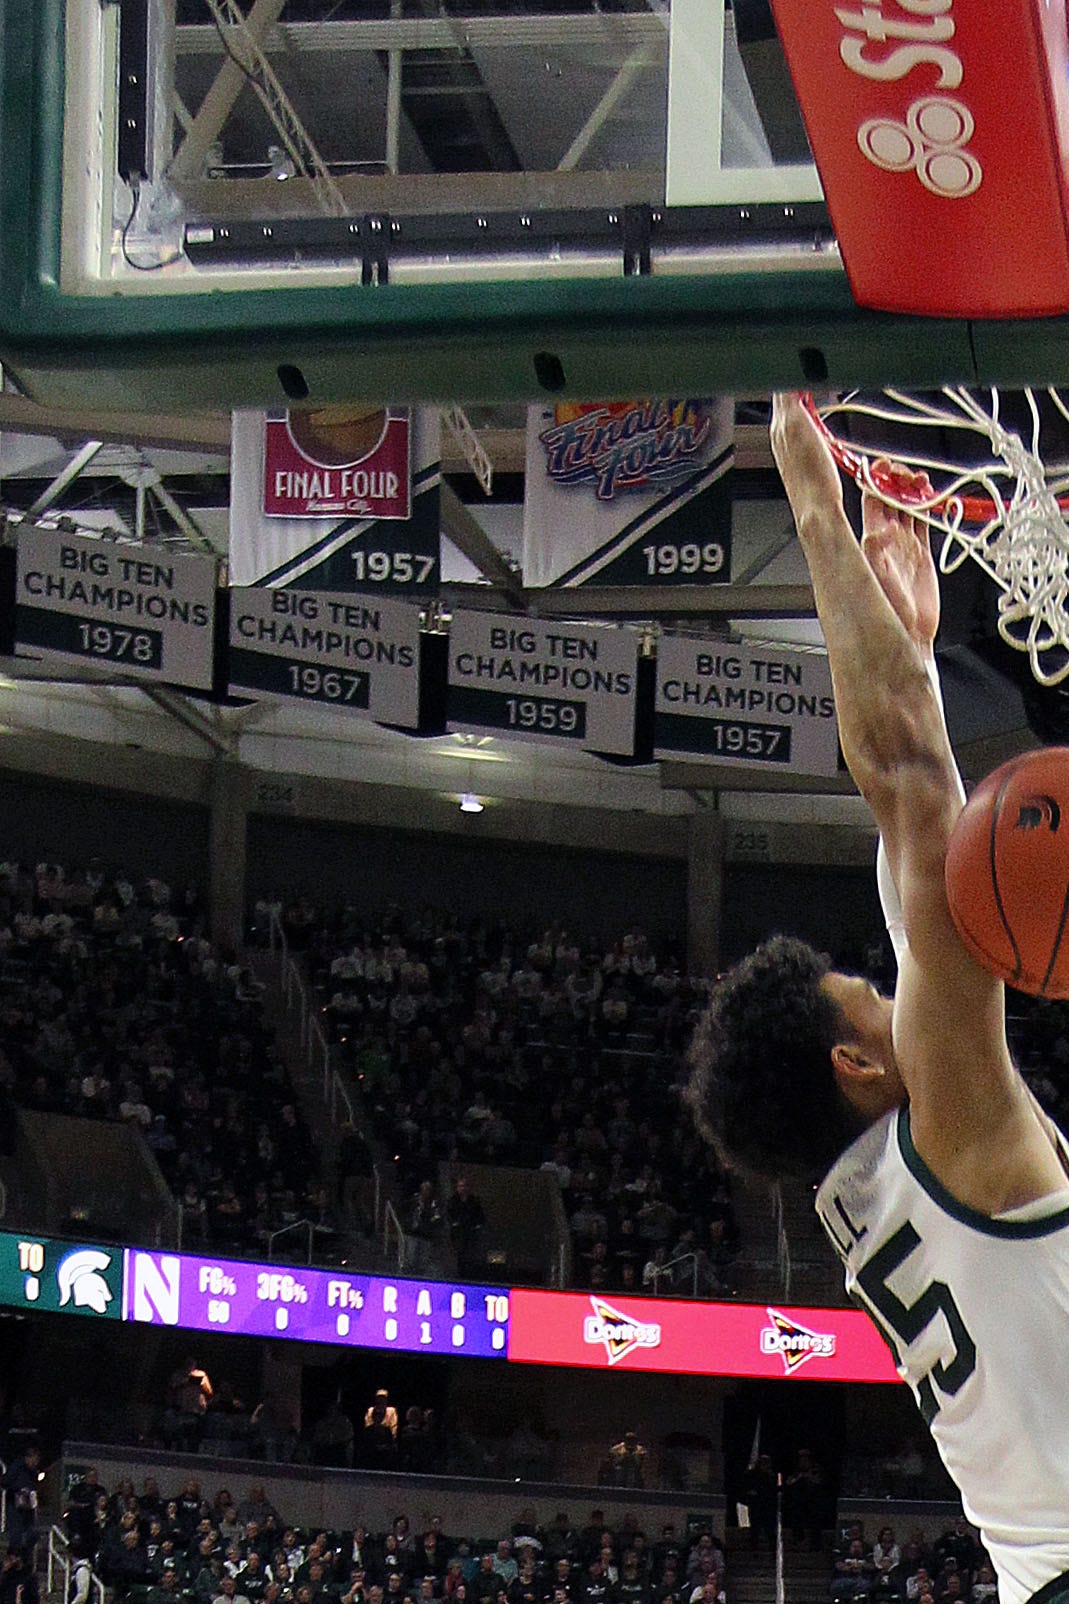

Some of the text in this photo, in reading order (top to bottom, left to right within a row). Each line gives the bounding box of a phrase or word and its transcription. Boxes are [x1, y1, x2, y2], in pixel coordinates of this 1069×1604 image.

[275, 471, 399, 499] FINAL FOUR
[60, 545, 174, 590] BIG TEN
[351, 551, 436, 584] 1957
[643, 543, 724, 575] 1999
[24, 571, 210, 627] CHAMPIONS
[272, 589, 381, 632] BIG TEN
[79, 623, 153, 661] 1978
[236, 614, 414, 668] CHAMPIONS
[490, 627, 598, 663] BIG TEN
[287, 664, 362, 700] 1967
[455, 653, 633, 696] CHAMPIONS
[696, 653, 802, 687] BIG TEN
[505, 698, 578, 732] 1959
[662, 680, 835, 719] CHAMPIONS
[712, 724, 782, 757] 1957
[134, 1252, 181, 1326] N
[199, 1265, 237, 1296] FG%
[257, 1272, 308, 1304] 3FG%
[327, 1280, 364, 1310] FT%
[382, 1285, 398, 1314] R
[416, 1289, 432, 1317] A
[419, 1321, 432, 1345] 1
[586, 1317, 659, 1345] Doritos
[763, 1329, 834, 1353] Doritos
